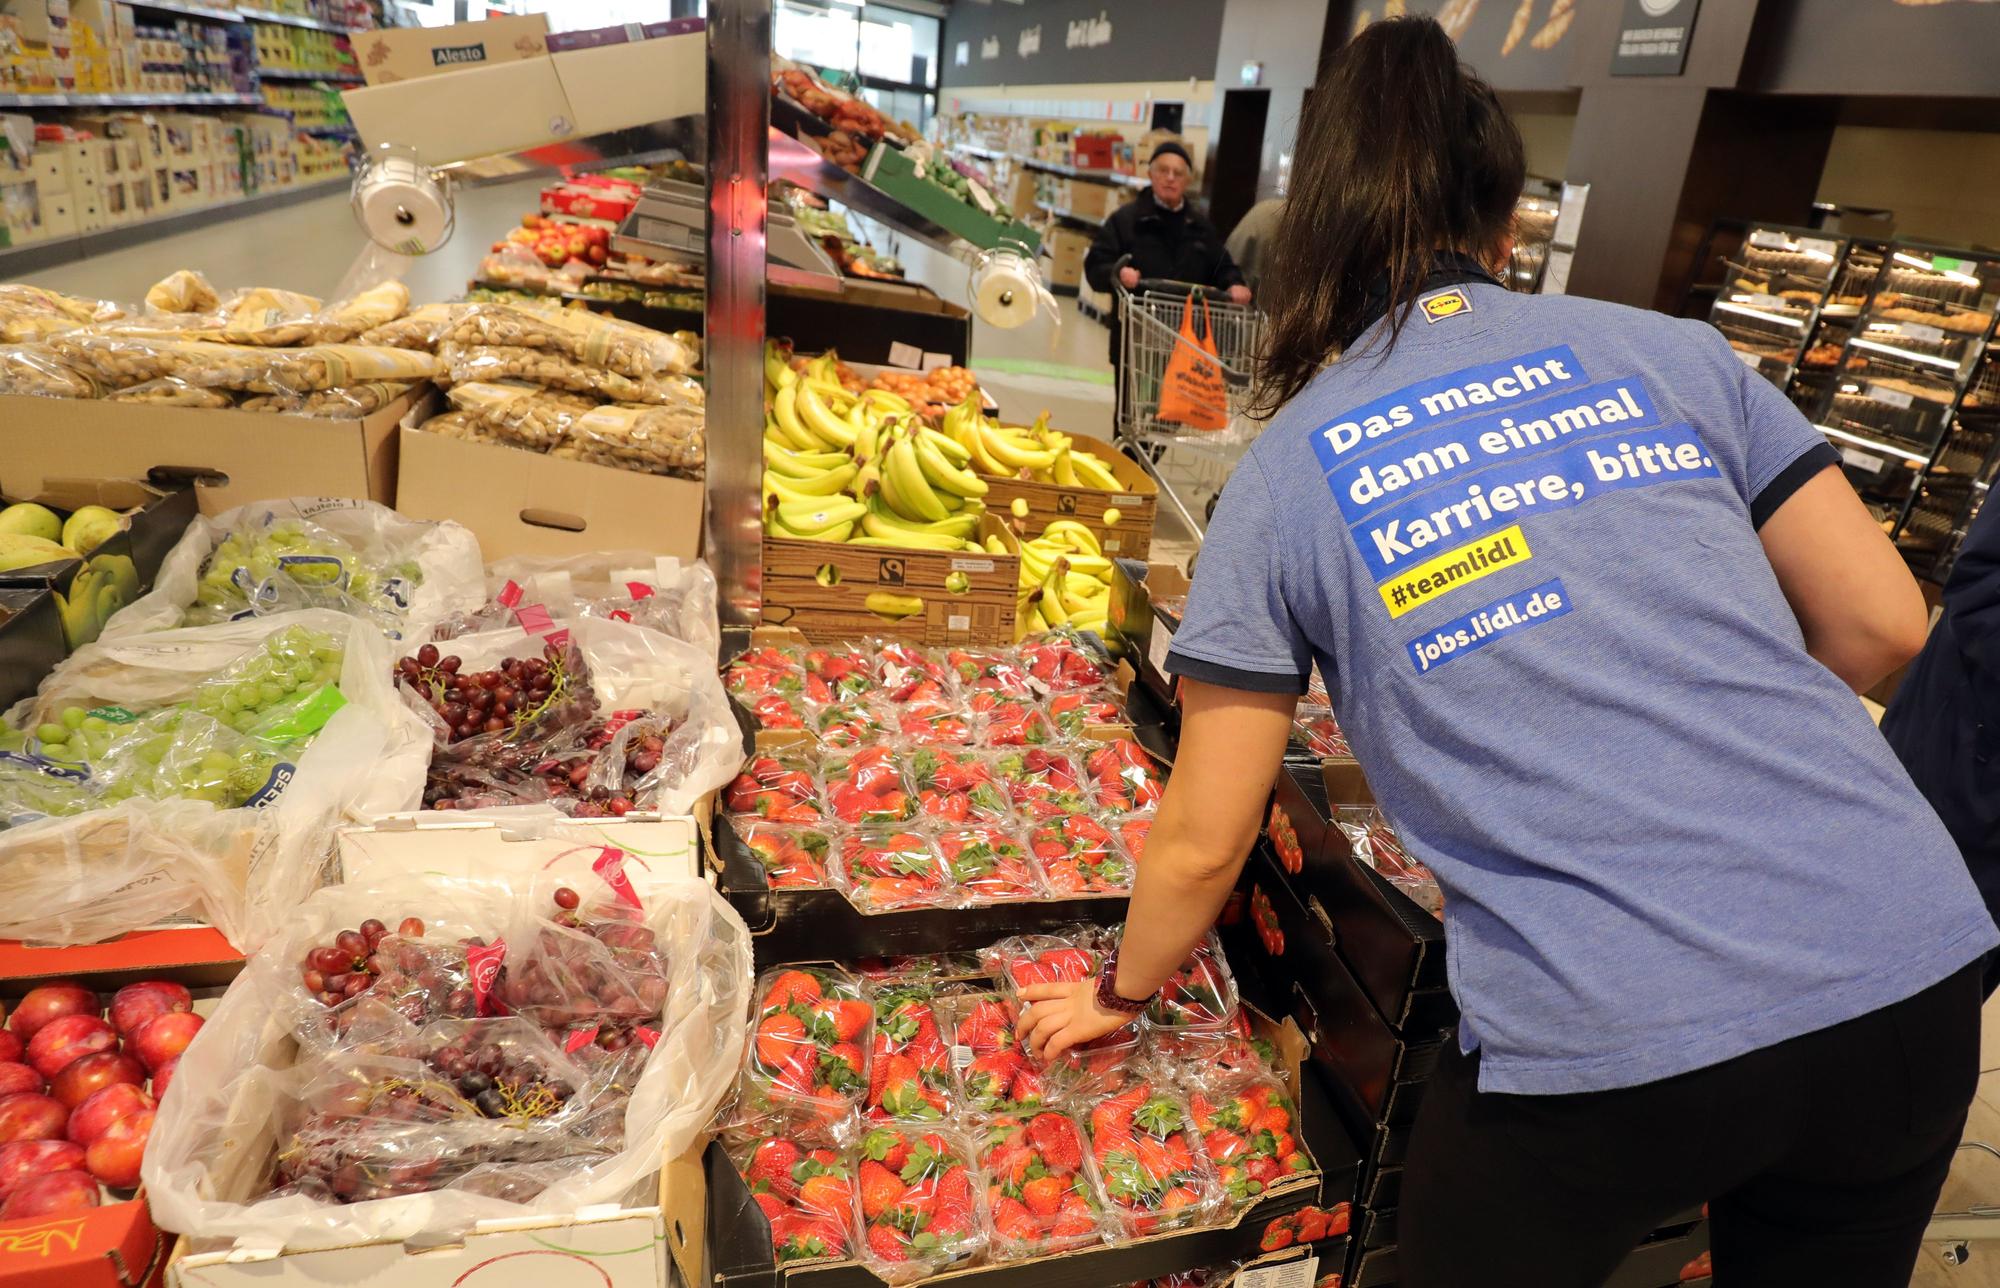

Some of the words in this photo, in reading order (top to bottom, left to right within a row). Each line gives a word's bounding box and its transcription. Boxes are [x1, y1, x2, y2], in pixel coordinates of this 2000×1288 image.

[436, 48, 482, 64] Alesto
[1323, 401, 1413, 455] Das
[1420, 358, 1572, 417] macht
[1349, 439, 1470, 505] dann
[1478, 388, 1644, 456] einmal
[1370, 472, 1584, 565] Karriere,
[1586, 440, 1712, 482] bitte.
[1391, 536, 1517, 608] #teamlidl
[1414, 588, 1562, 671] jobs.lidl.de
